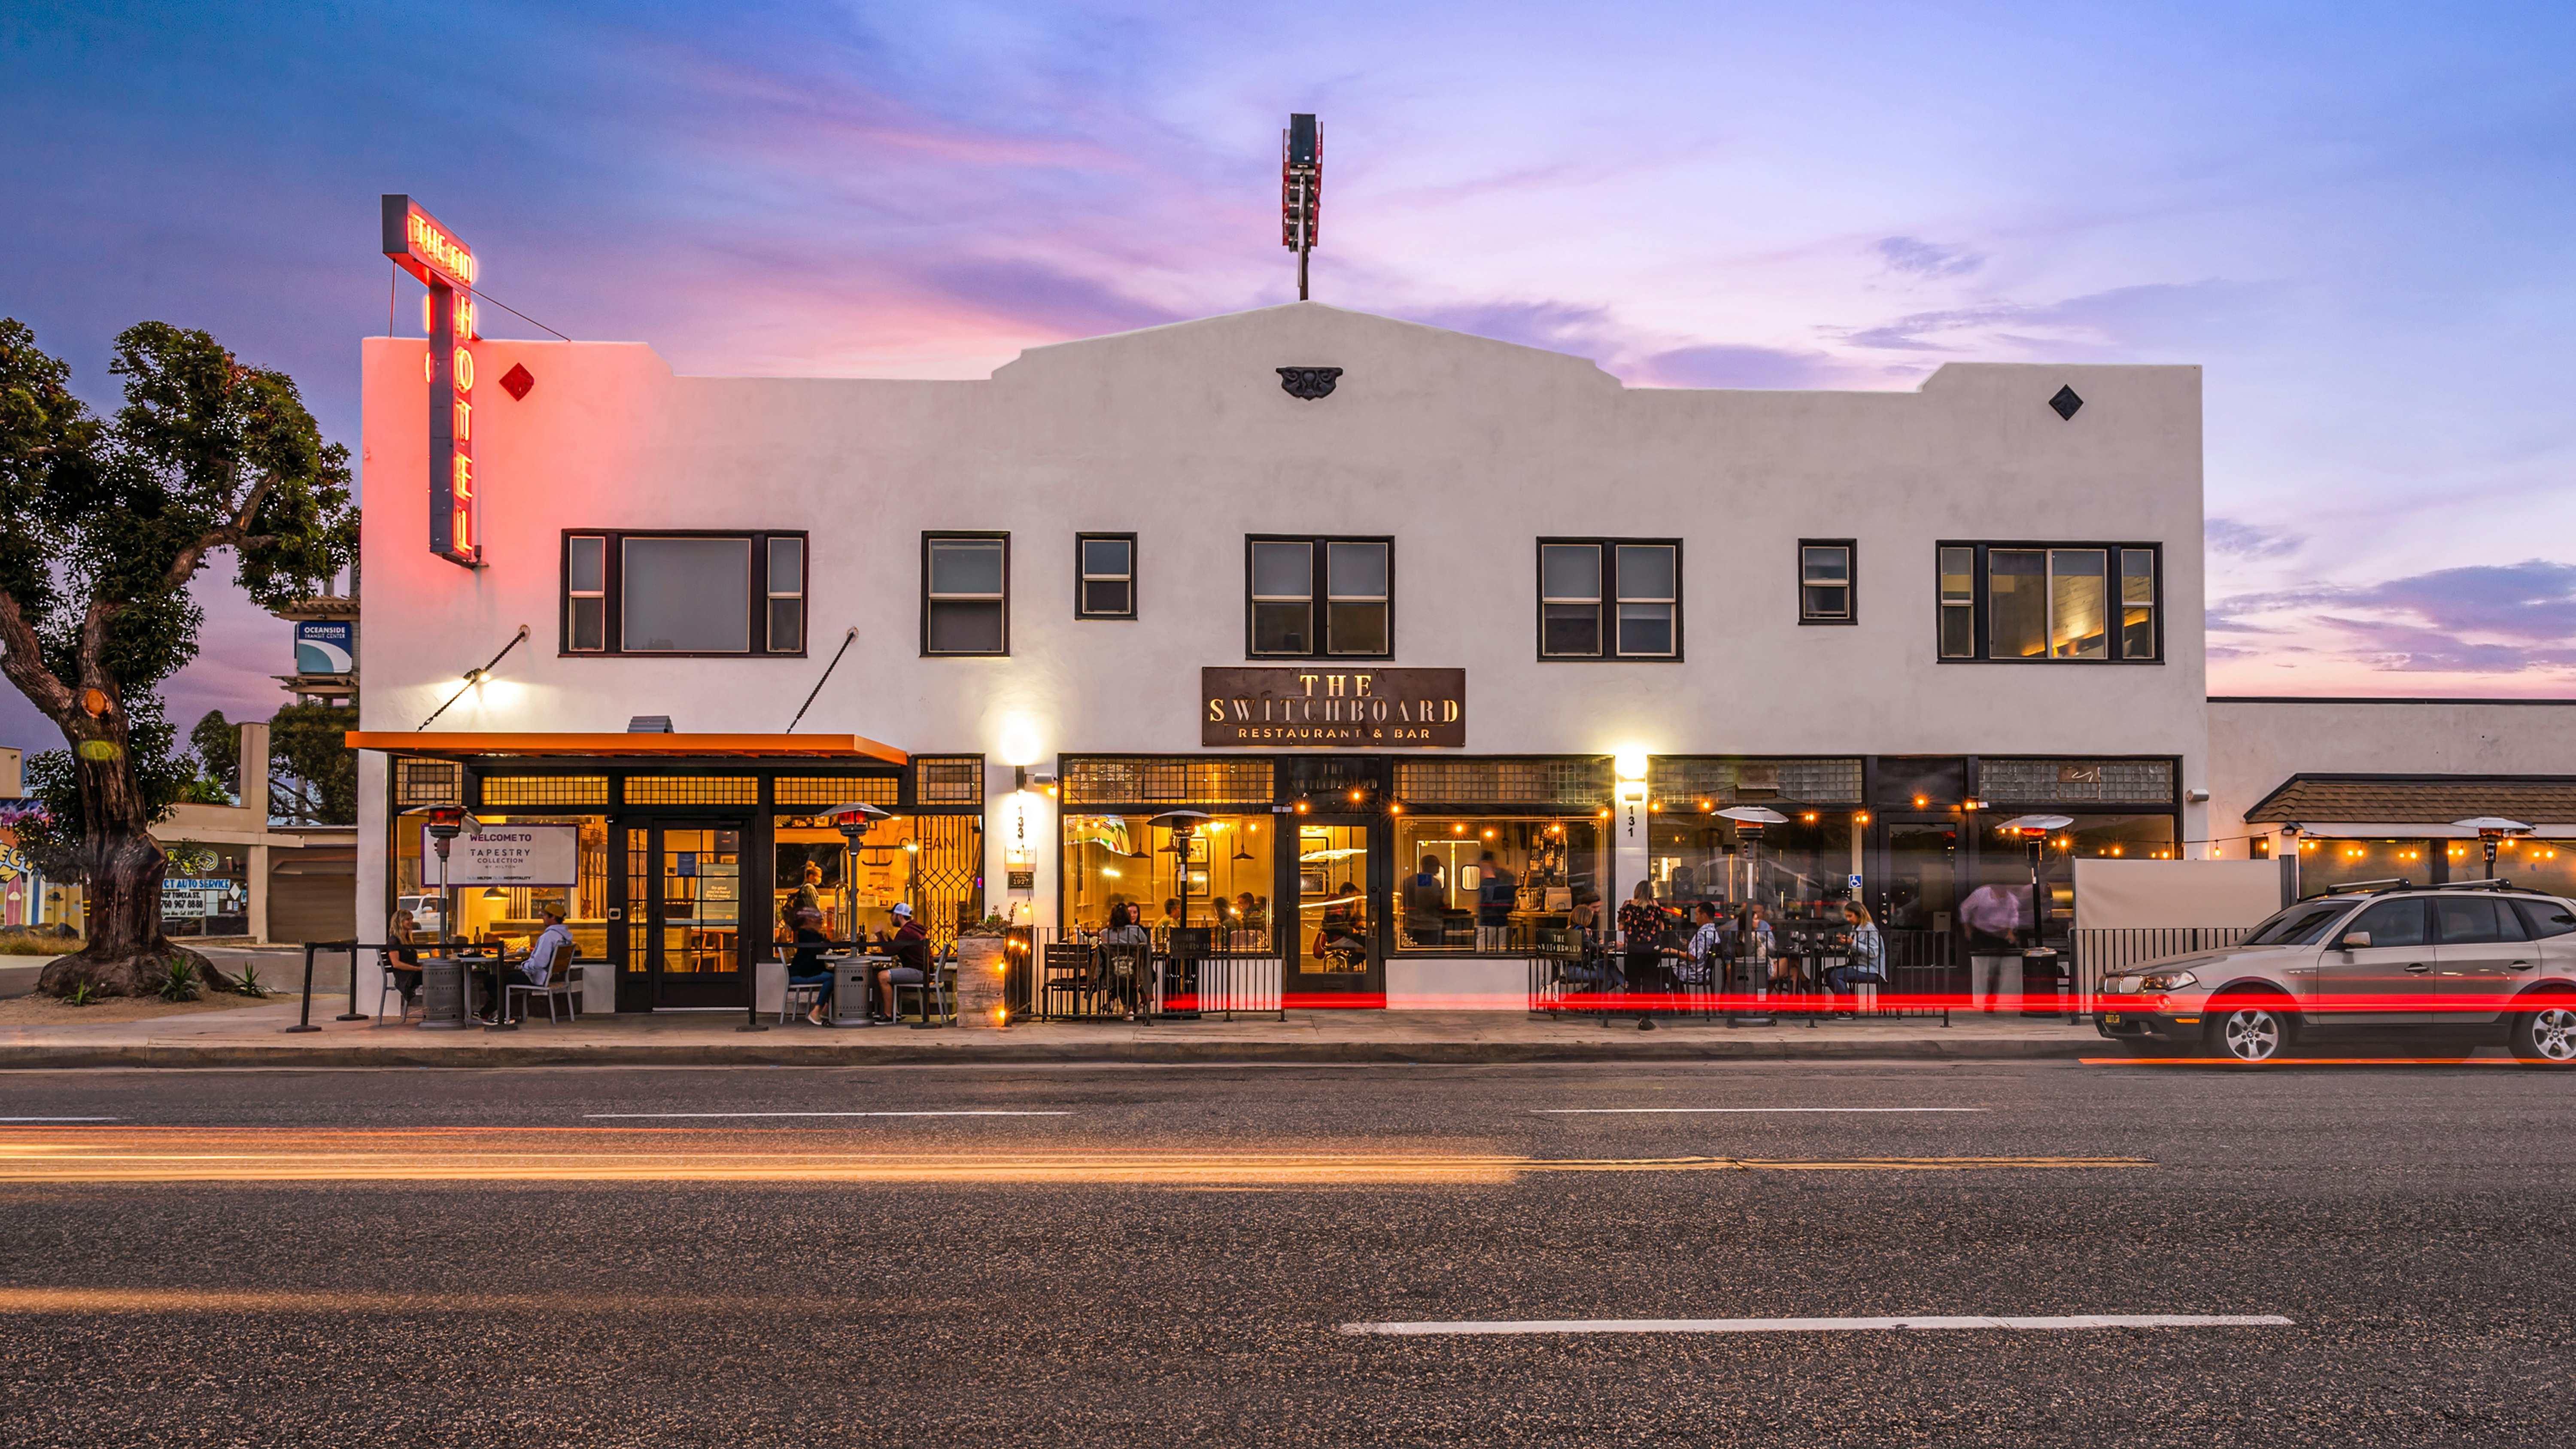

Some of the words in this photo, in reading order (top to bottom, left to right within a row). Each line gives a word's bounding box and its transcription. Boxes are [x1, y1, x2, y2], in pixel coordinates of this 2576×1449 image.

[408, 212, 445, 268] THE
[446, 243, 473, 284] FIN
[454, 295, 474, 555] HOTEL
[1300, 675, 1371, 697] THE
[1210, 699, 1458, 722] SWITCHBOARD
[1239, 729, 1361, 738] RESTAURANT
[1373, 729, 1382, 738] &
[1394, 729, 1430, 738] BAR
[177, 879, 197, 888] AUTO
[199, 879, 229, 889] SERVICE
